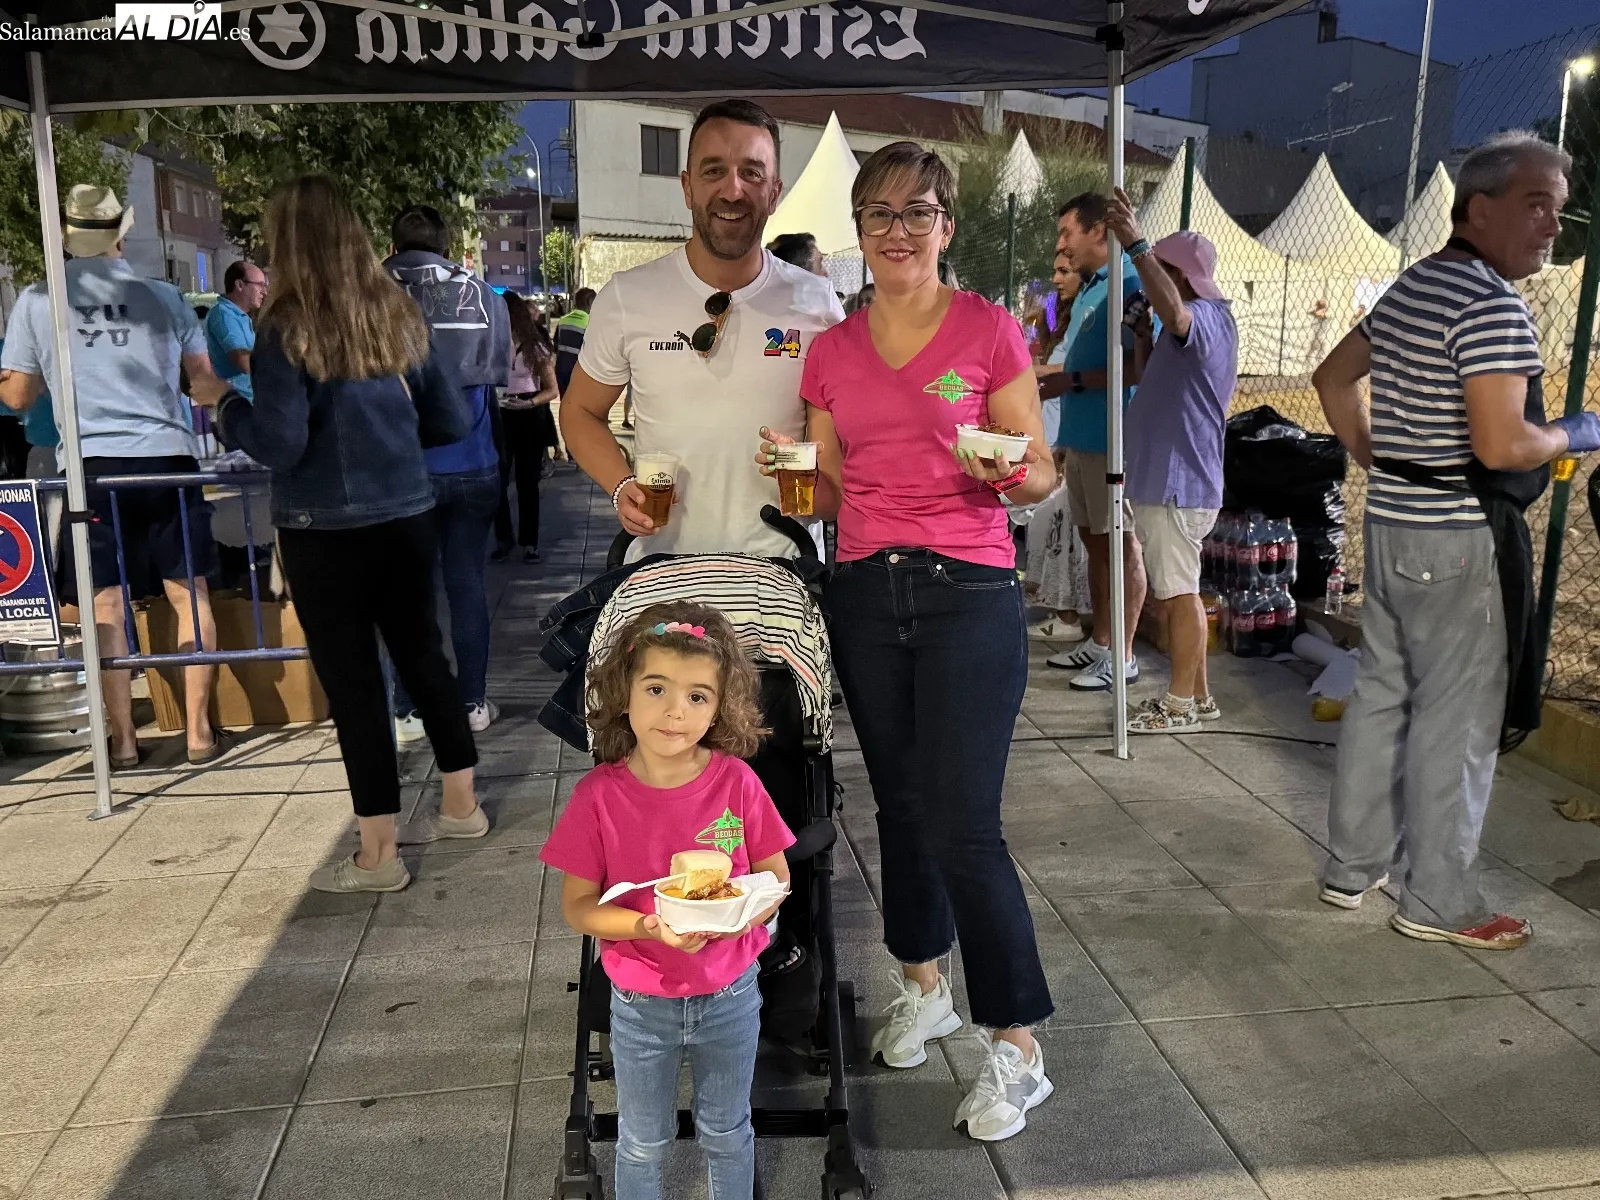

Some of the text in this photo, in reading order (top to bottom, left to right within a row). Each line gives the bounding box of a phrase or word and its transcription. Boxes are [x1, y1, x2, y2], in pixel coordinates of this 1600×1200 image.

[76, 328, 131, 348] YU
[763, 327, 801, 359] 24
[0, 597, 28, 607] EÑARANDA
[5, 606, 50, 619] LOCAL
